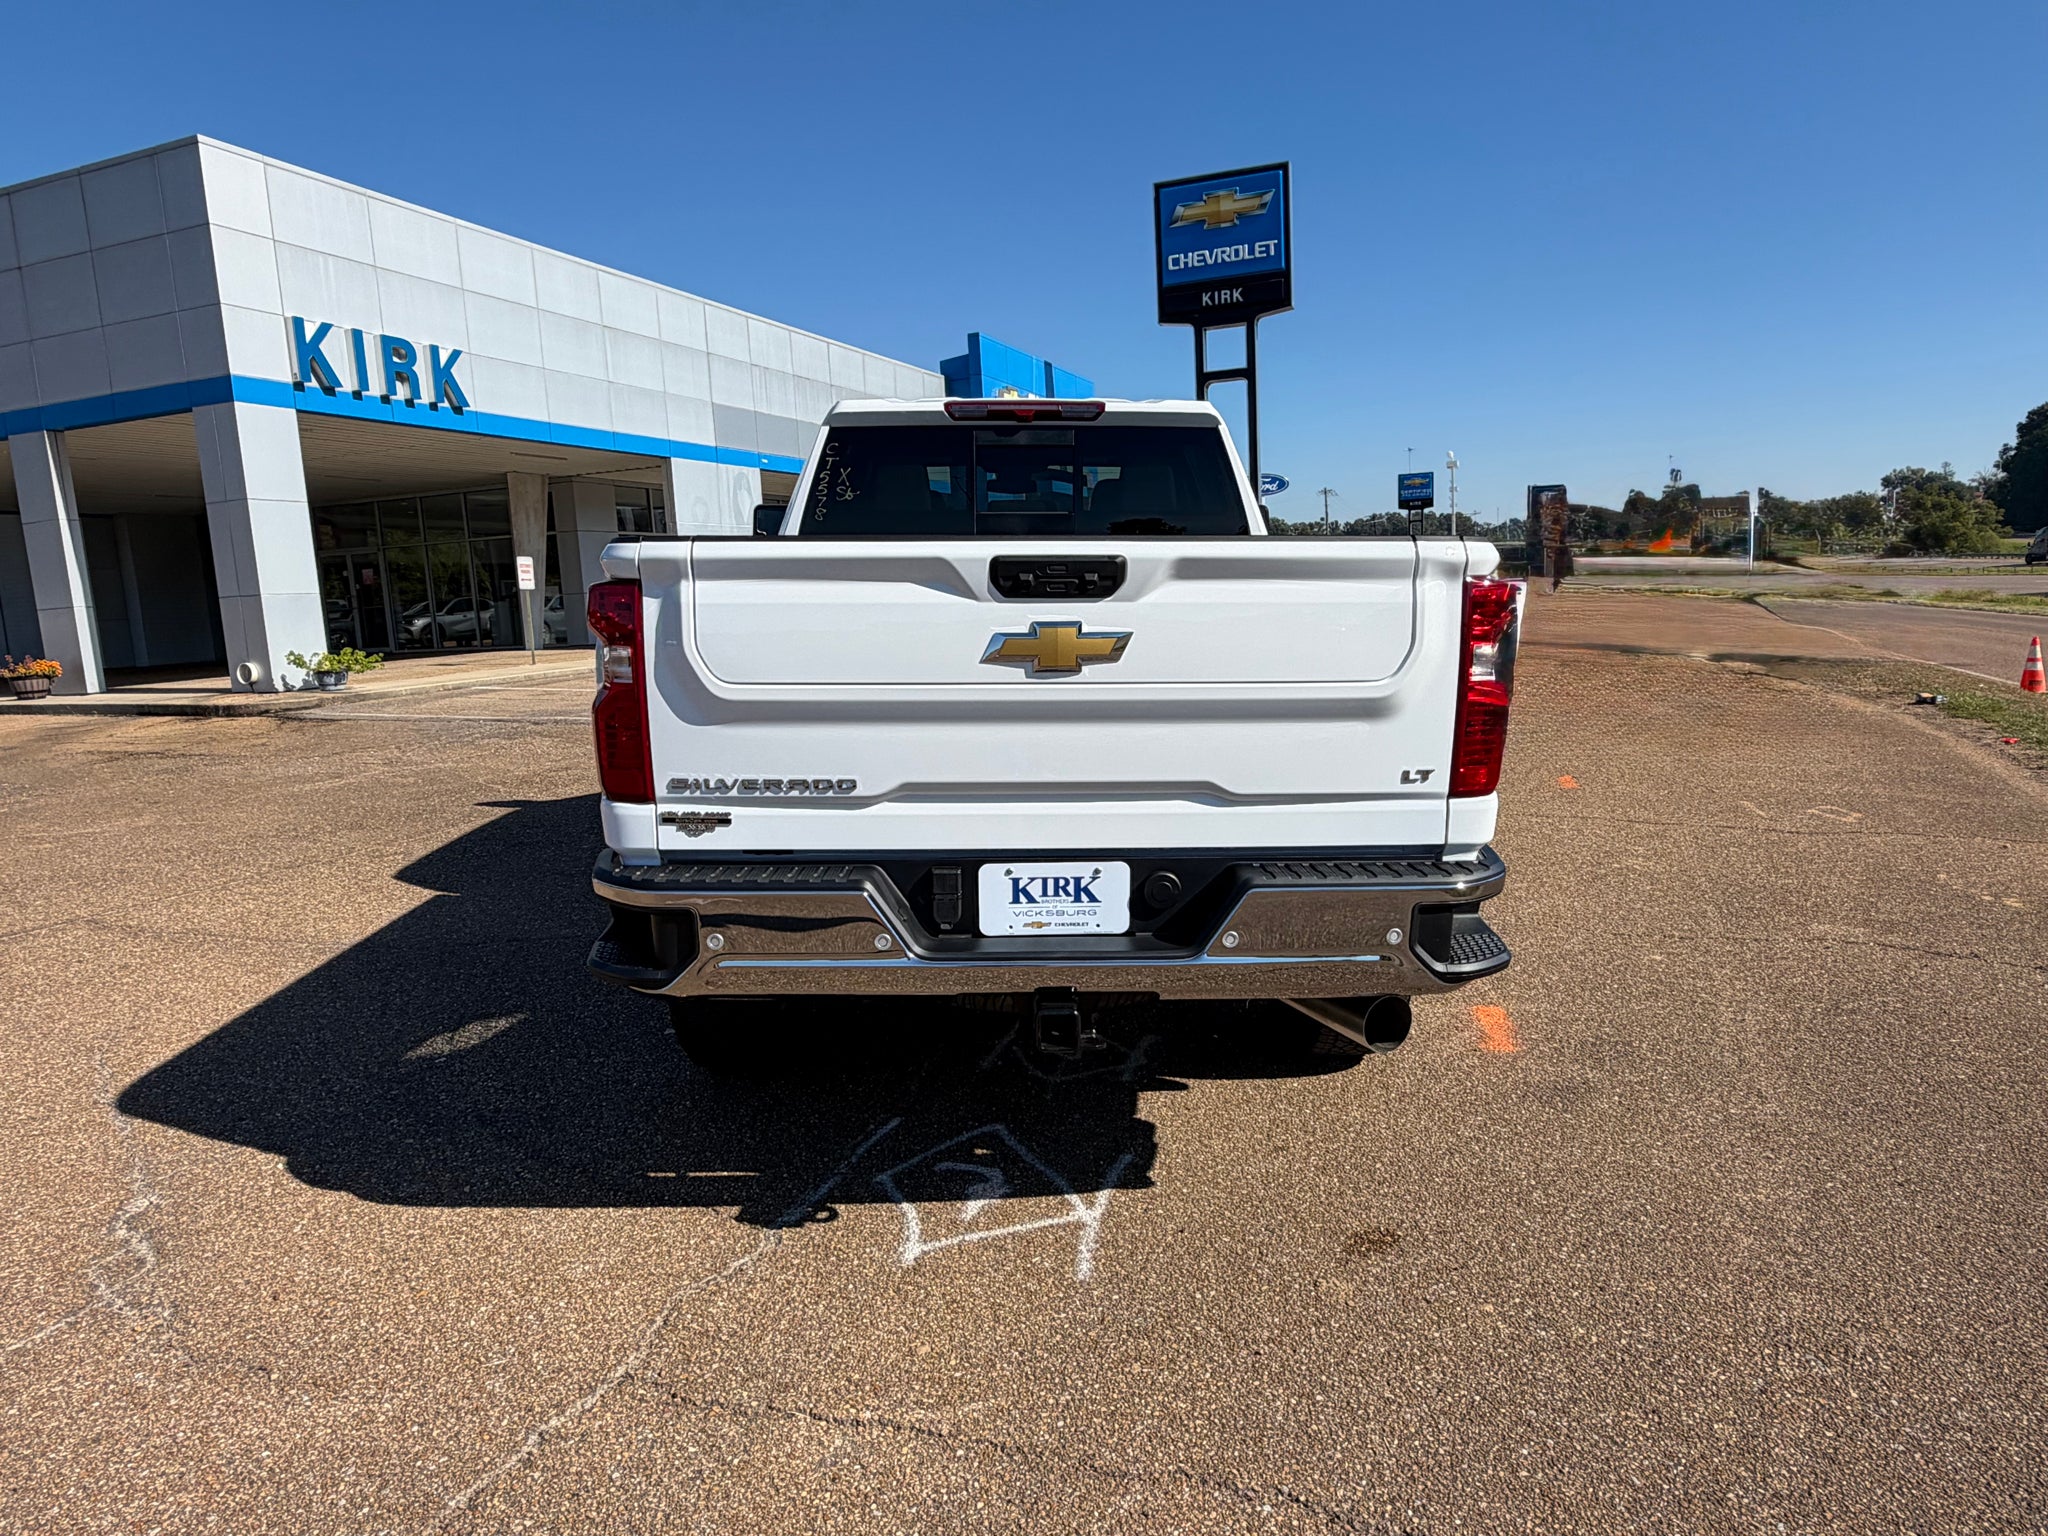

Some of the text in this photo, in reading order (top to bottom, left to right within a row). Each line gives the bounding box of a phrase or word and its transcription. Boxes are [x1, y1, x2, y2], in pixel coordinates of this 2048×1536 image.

[1168, 240, 1278, 270] CHEVROLET
[1202, 288, 1243, 306] KIRK
[290, 316, 470, 409] KIRK
[667, 778, 857, 794] SILVERADO
[1400, 769, 1435, 785] LT
[1008, 876, 1102, 904] KIRK
[1012, 909, 1097, 917] VICKSBURG
